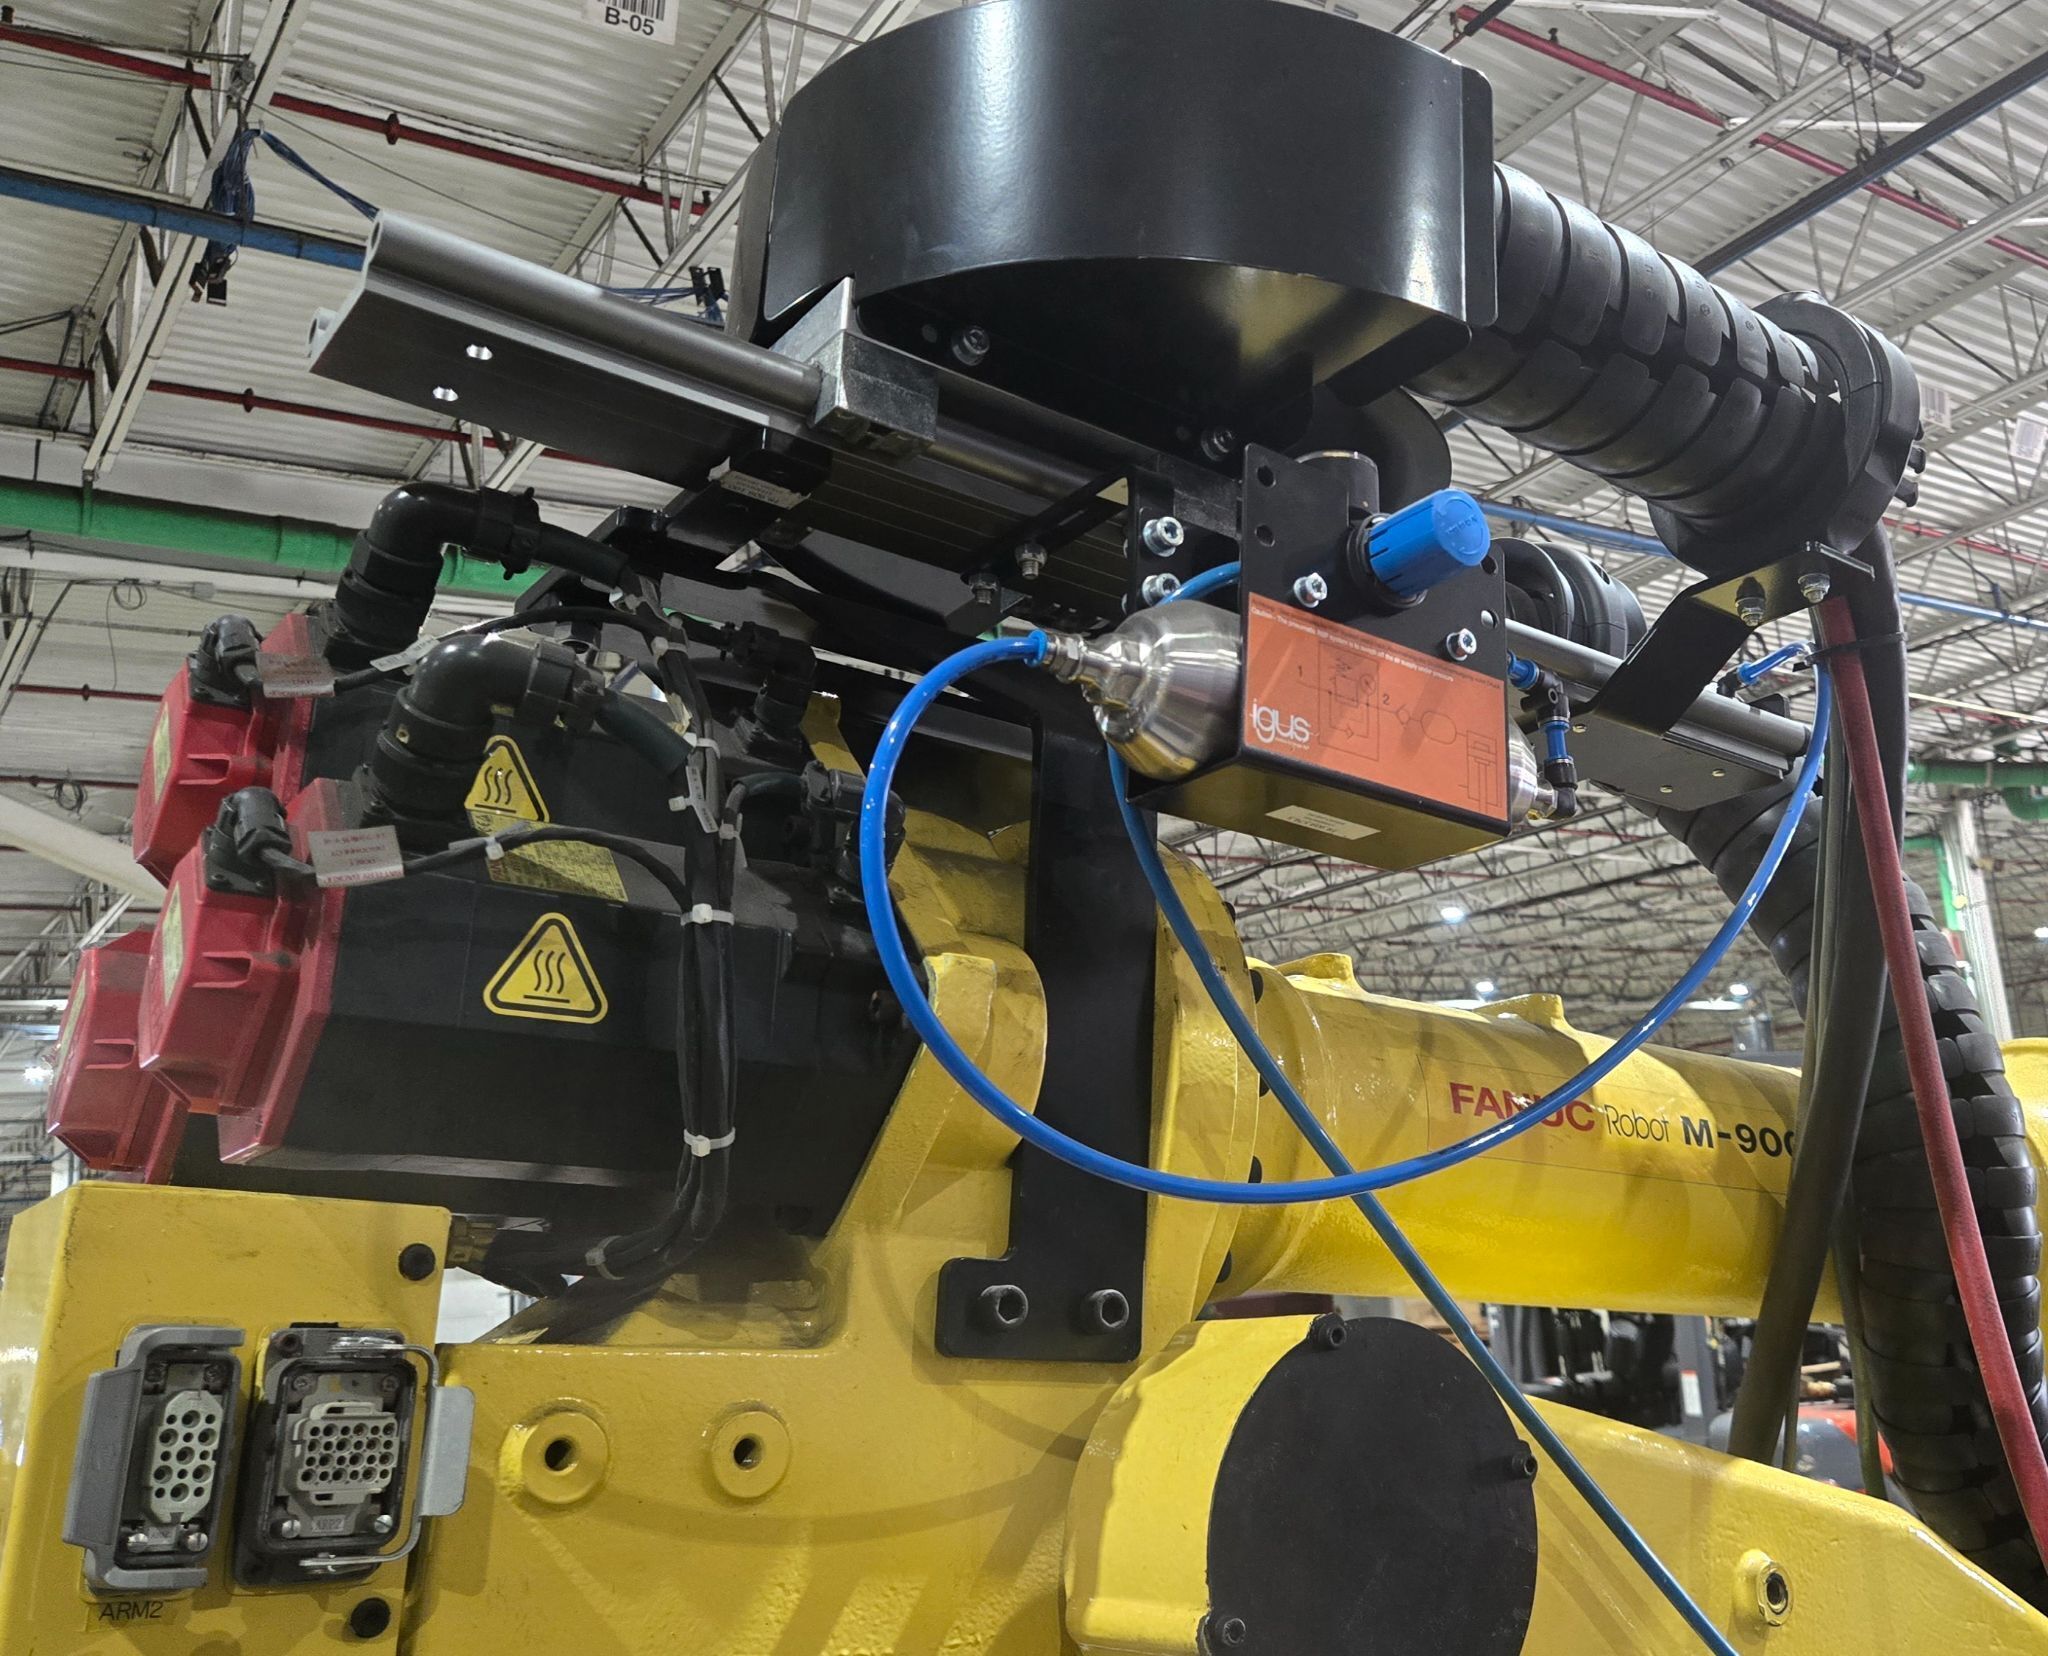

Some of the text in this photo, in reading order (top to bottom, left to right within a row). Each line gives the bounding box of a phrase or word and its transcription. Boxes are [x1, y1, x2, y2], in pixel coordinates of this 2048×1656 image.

[604, 6, 655, 36] B-05
[1382, 693, 1390, 706] 2
[1251, 698, 1312, 744] igus
[1604, 1104, 1670, 1143] Robot
[98, 1600, 164, 1621] ARM2
